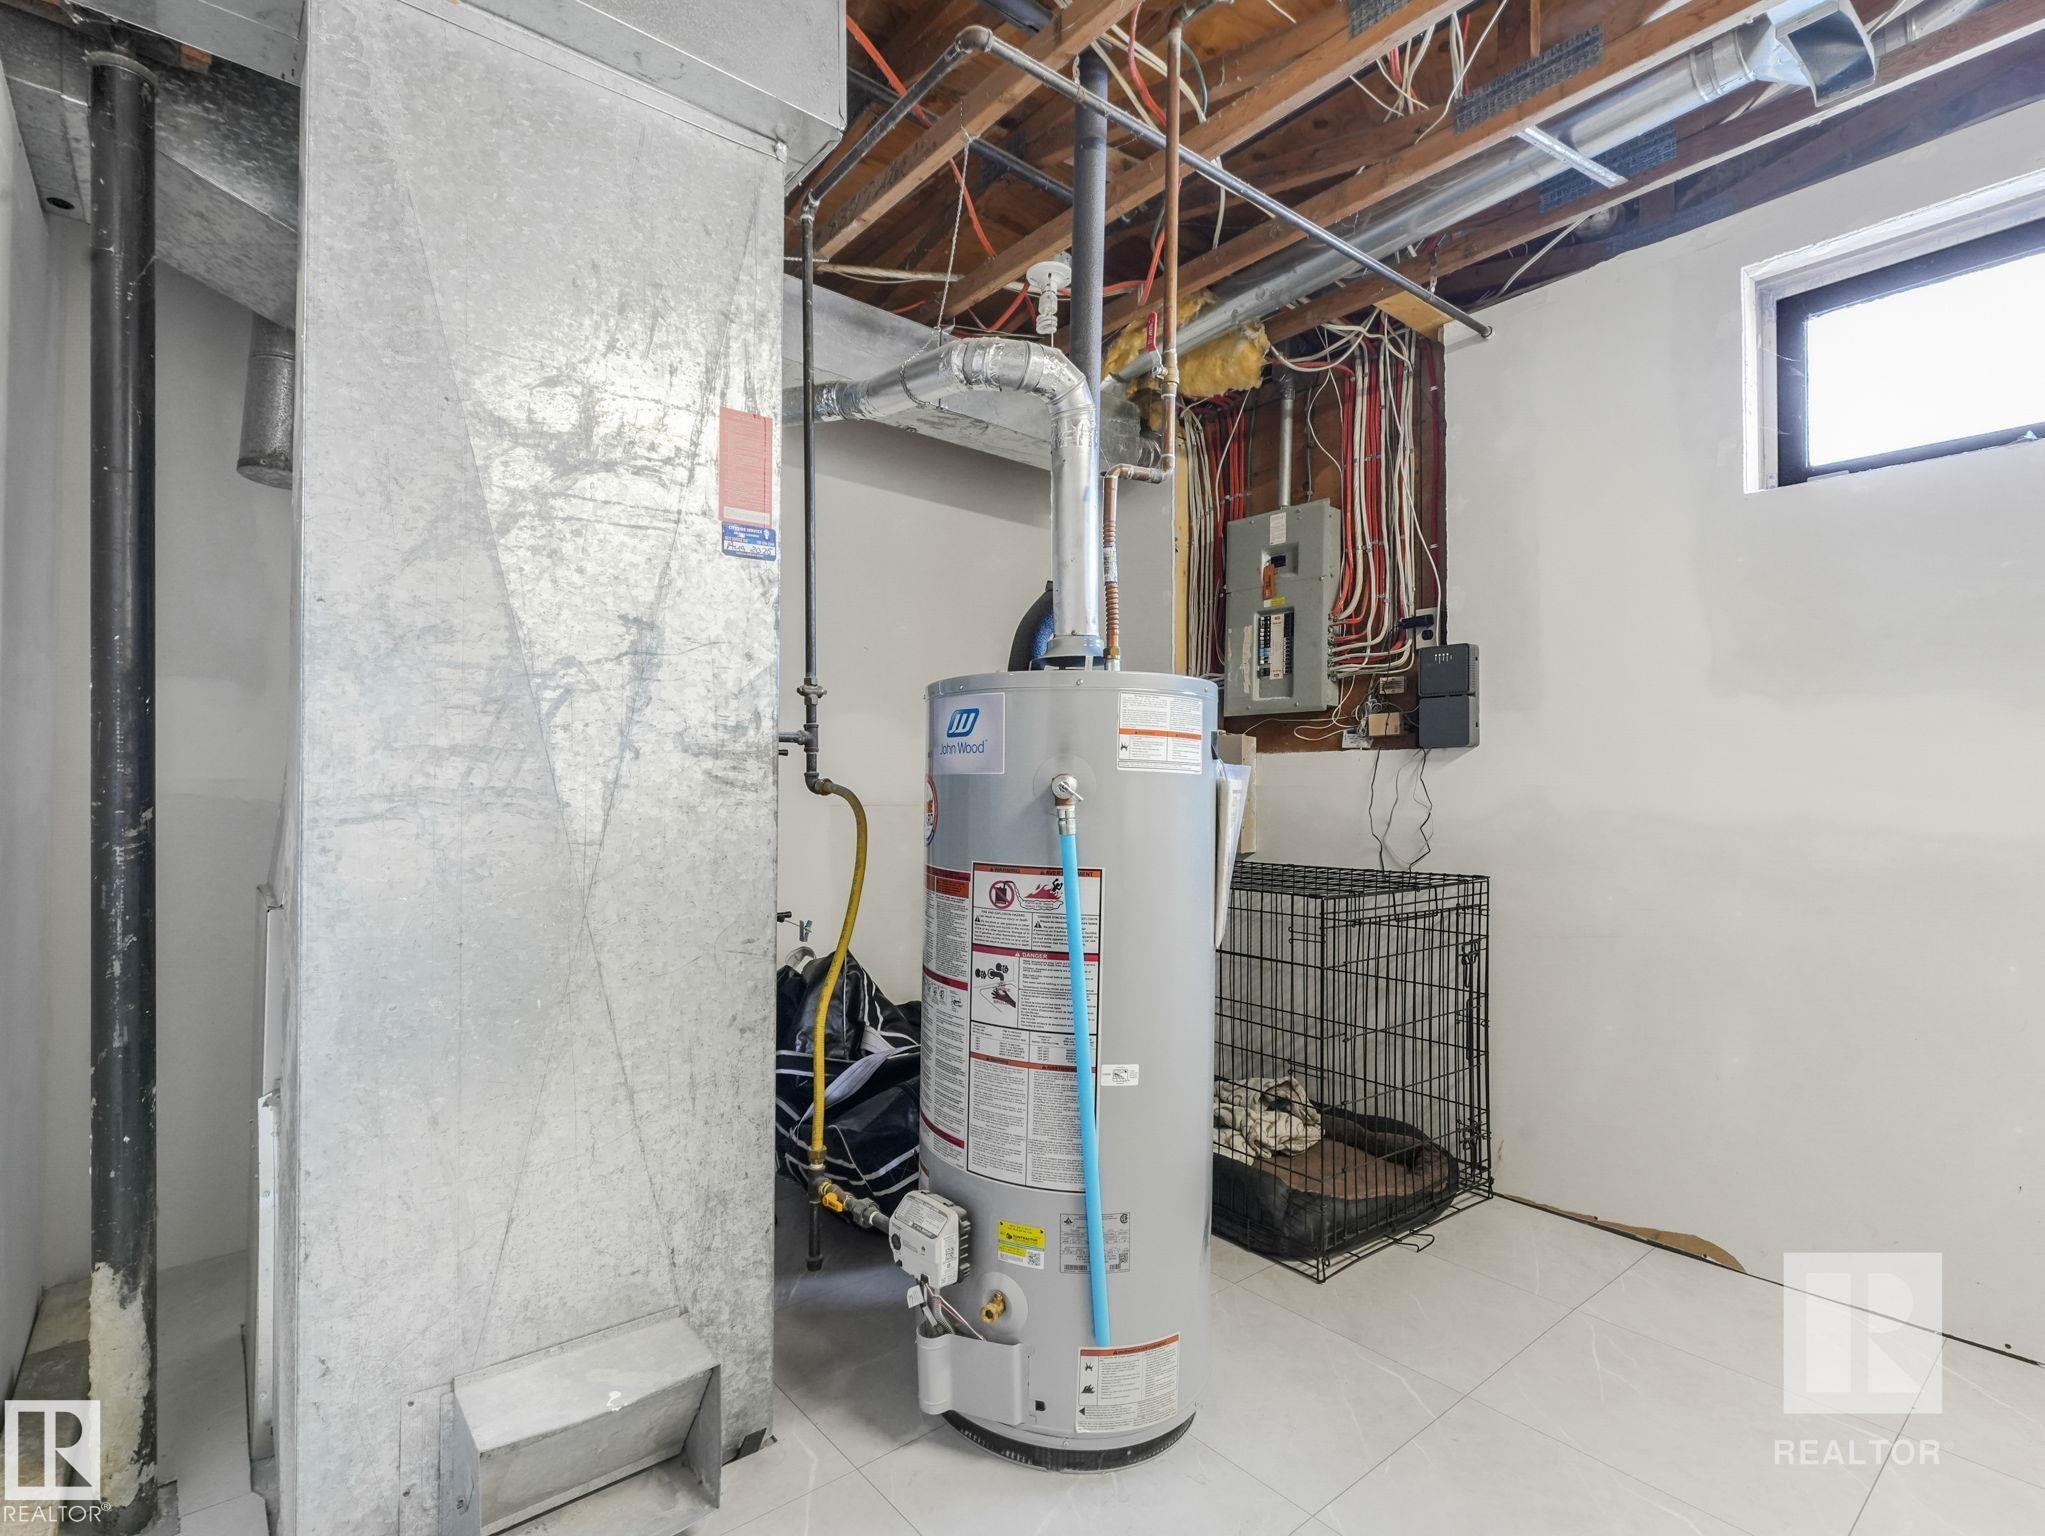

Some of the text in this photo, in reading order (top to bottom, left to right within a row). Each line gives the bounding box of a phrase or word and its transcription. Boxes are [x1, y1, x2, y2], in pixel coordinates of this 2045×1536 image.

[940, 739, 985, 755] John Wood
[994, 866, 1020, 874] WARNING
